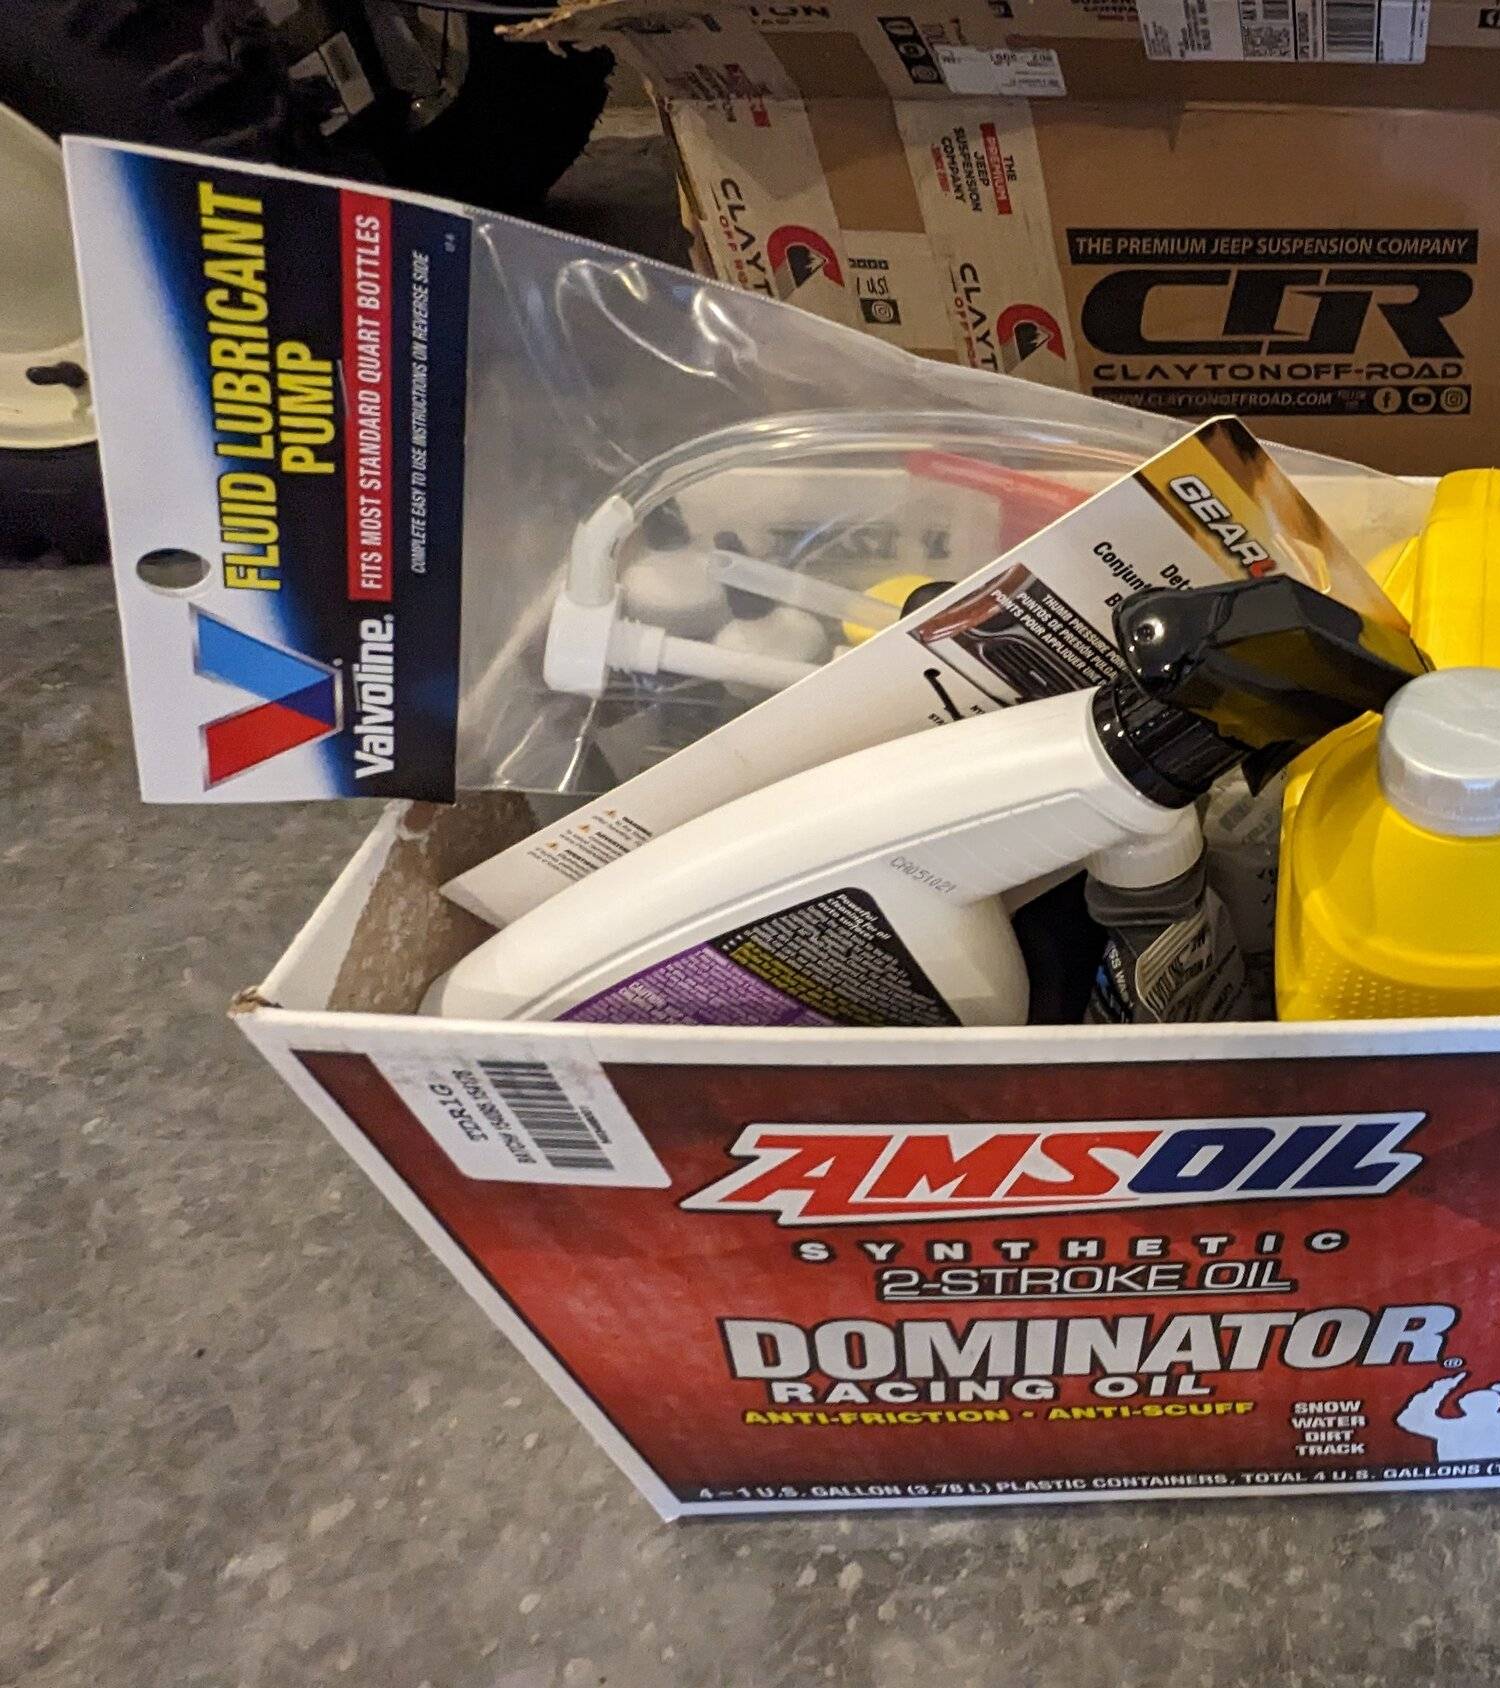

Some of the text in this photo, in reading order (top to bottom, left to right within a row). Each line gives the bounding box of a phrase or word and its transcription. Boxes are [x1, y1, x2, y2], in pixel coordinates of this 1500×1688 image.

[941, 136, 967, 203] COMPANY
[953, 127, 983, 212] SUSPENSION
[974, 151, 990, 187] JEEP
[986, 136, 1008, 201] PREMIUM
[1003, 155, 1017, 182] THE
[720, 178, 775, 298] CLAYT
[1076, 237, 1469, 256] THE PREMIUM JEEP SUSPENSION COMPANY
[960, 262, 998, 371] CLAYT
[198, 181, 282, 590] FLUID LUBRICANT
[277, 340, 336, 474] PUMP
[355, 214, 384, 590] FITS MOST STANDARD QUART BOTTLES
[411, 249, 429, 574] COMPLETE EASY TO USE INSTRUCTIONS ON REVERSE SIDE
[1159, 563, 1194, 591] Det
[990, 589, 1025, 619] POINTS
[1020, 613, 1047, 636] POUR
[1040, 633, 1087, 670] APPLIQUER
[1017, 591, 1052, 623] PUNTOS
[1046, 618, 1064, 633] DE
[1089, 655, 1120, 681] PULGA
[1041, 594, 1073, 622] THUMB
[1068, 617, 1112, 655] PRESSURE
[355, 617, 394, 778] Valvoline
[837, 893, 879, 922] Powerful
[715, 1119, 1405, 1220] AMSOIL
[799, 1230, 1351, 1263] SYNTHETIC
[882, 1261, 1293, 1297] 2-STROKE OIL
[722, 1304, 1458, 1381] DOMINATOR
[744, 1400, 1256, 1426] ANTI-FRICTION ANTI-SCUFF
[770, 1374, 1213, 1404] RACING OIL
[1294, 1400, 1363, 1414] SNOW
[1291, 1414, 1367, 1428] WATER
[1294, 1443, 1366, 1457] TRACK
[1304, 1429, 1354, 1443] DIRT
[811, 1483, 901, 1498] GALLON
[967, 1482, 993, 1496] L)
[995, 1478, 1088, 1494] PLASTIC
[1239, 1471, 1306, 1484] TOTAL
[1311, 1470, 1327, 1482] 4
[1332, 1469, 1379, 1482] U.S.
[1383, 1464, 1482, 1480] GALLONS
